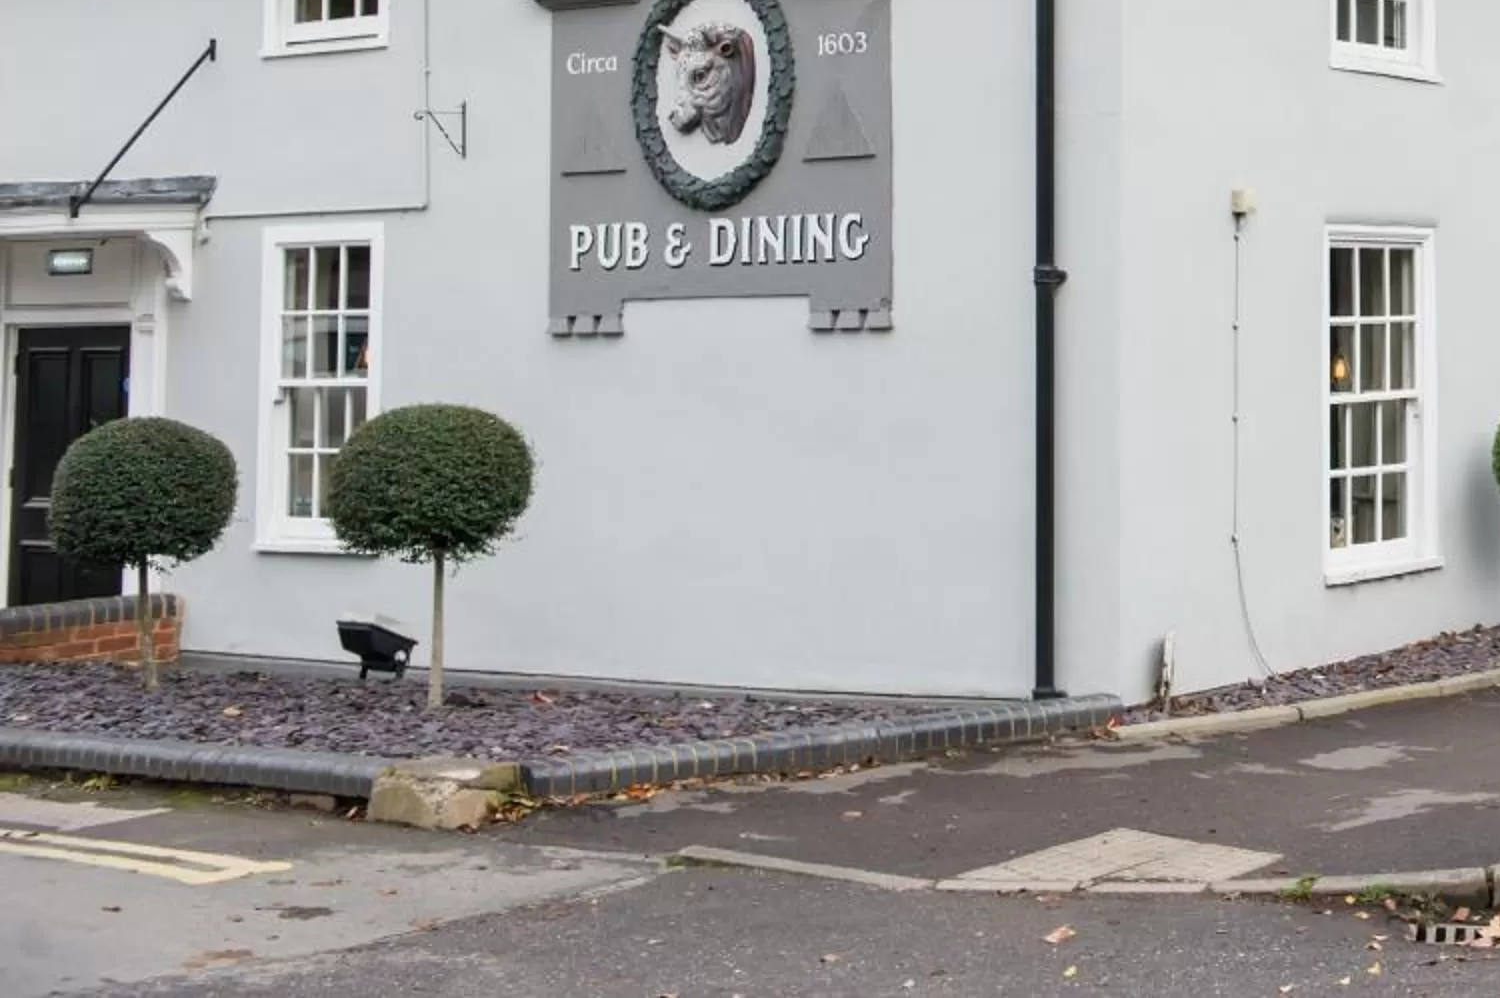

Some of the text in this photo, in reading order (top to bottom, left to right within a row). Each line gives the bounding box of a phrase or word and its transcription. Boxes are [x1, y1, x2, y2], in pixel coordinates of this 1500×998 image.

[817, 31, 867, 56] 1603
[567, 52, 618, 75] Circa
[568, 212, 871, 270] PUB & DINING
